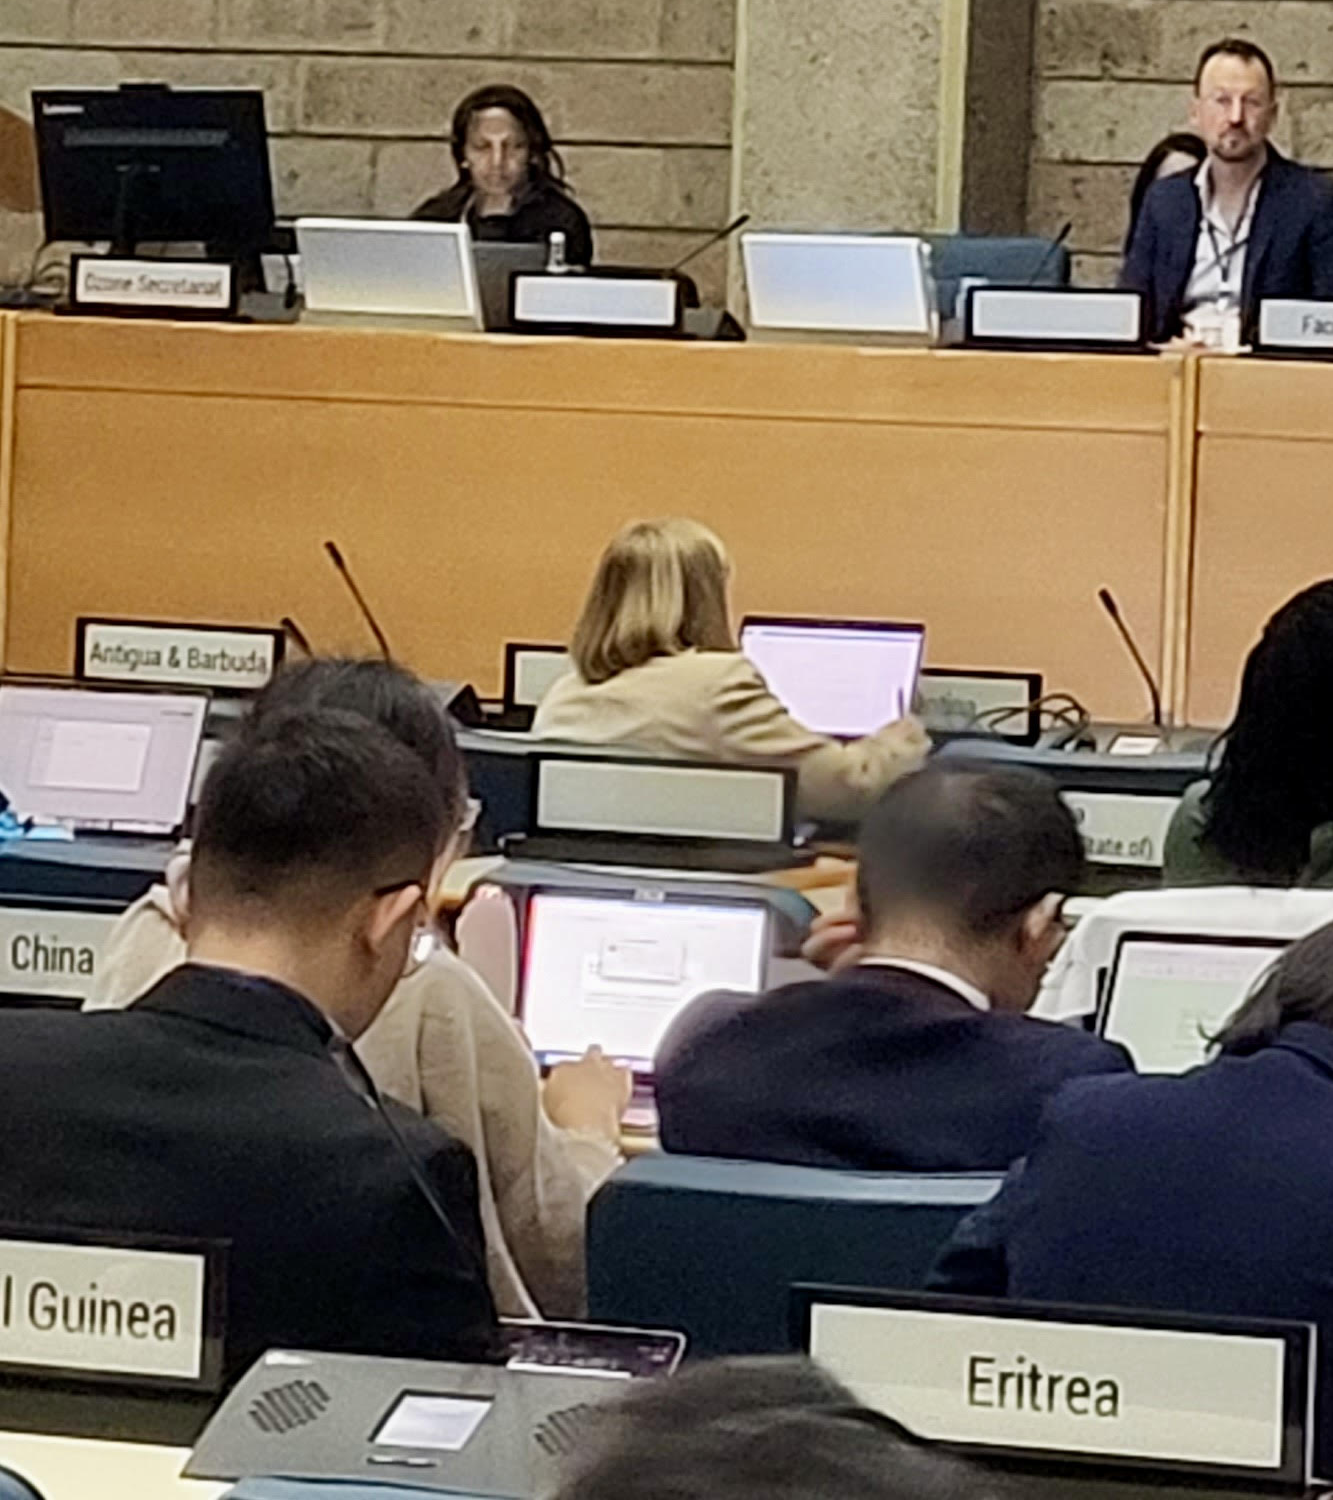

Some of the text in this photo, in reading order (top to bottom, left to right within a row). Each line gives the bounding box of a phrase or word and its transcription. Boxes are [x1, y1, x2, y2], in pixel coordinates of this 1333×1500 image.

[90, 641, 267, 675] Antigua & Barbuda
[11, 934, 94, 976] China
[29, 1281, 176, 1341] Guinea
[968, 1355, 1120, 1418] Eritrea
